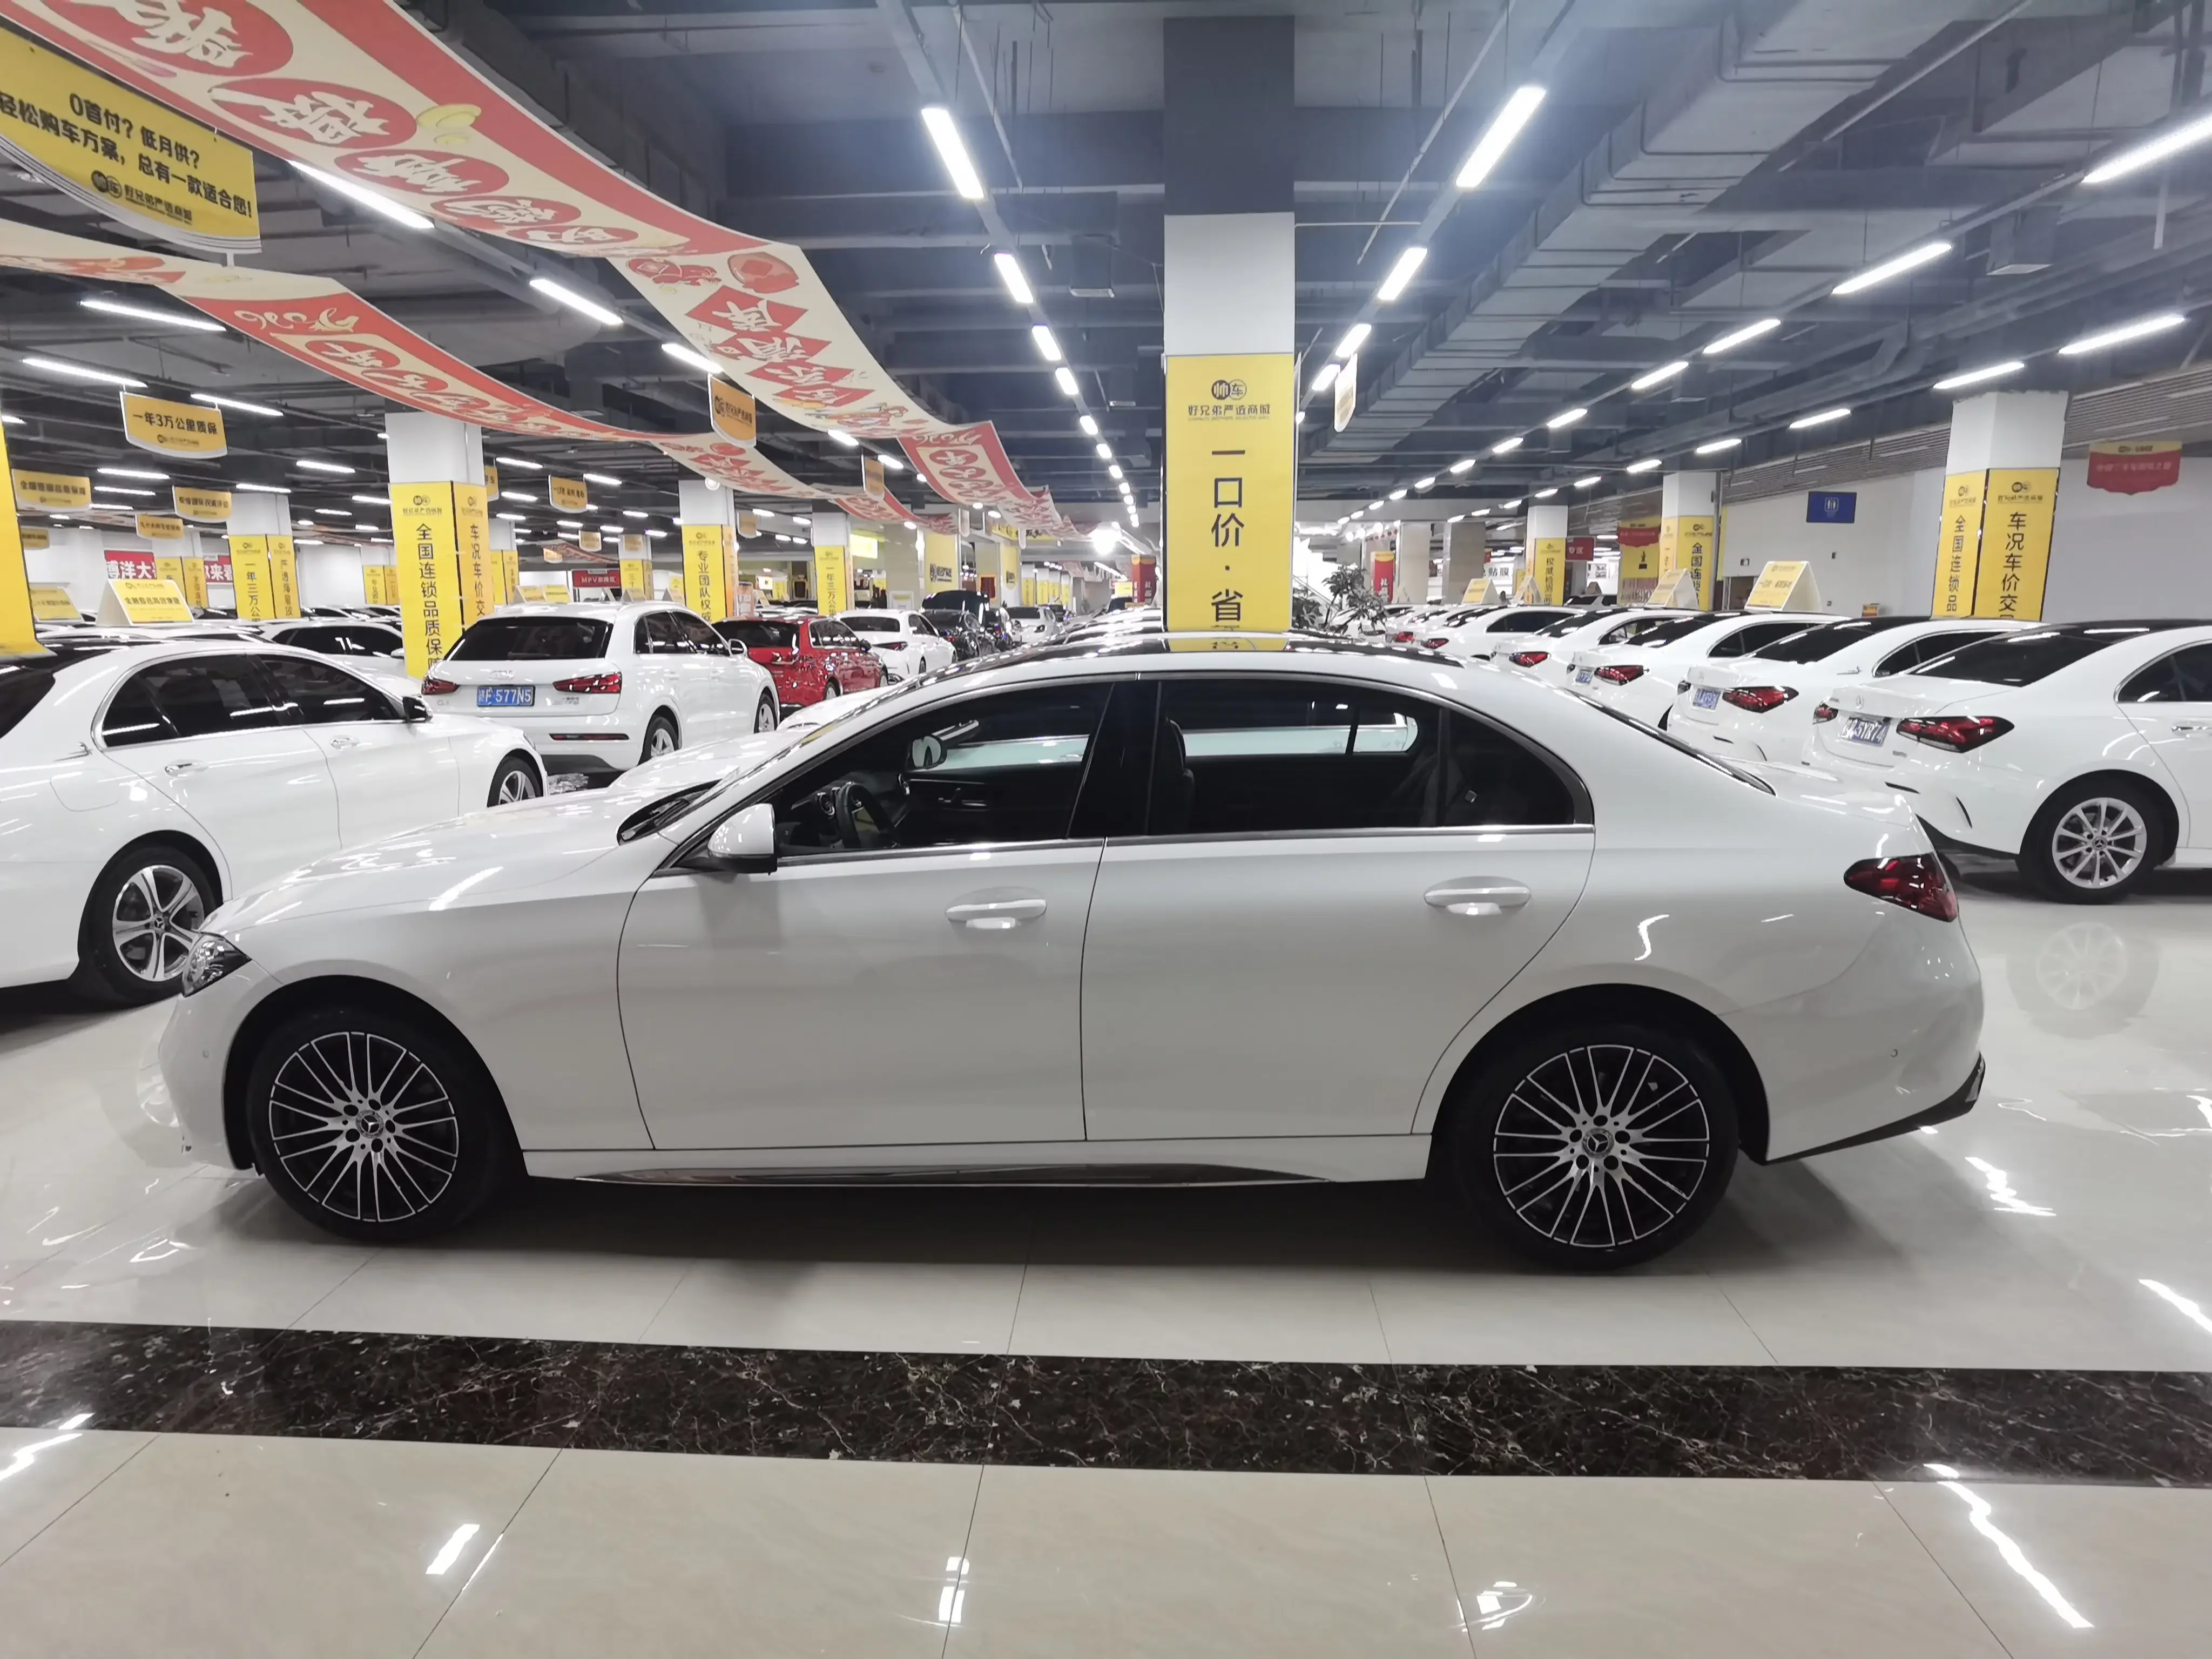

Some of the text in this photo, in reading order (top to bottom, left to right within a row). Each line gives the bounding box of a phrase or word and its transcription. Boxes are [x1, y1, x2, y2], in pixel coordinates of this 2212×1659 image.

[133, 412, 217, 435] 一年3万公里质保
[1211, 450, 1245, 629] 一口价·省
